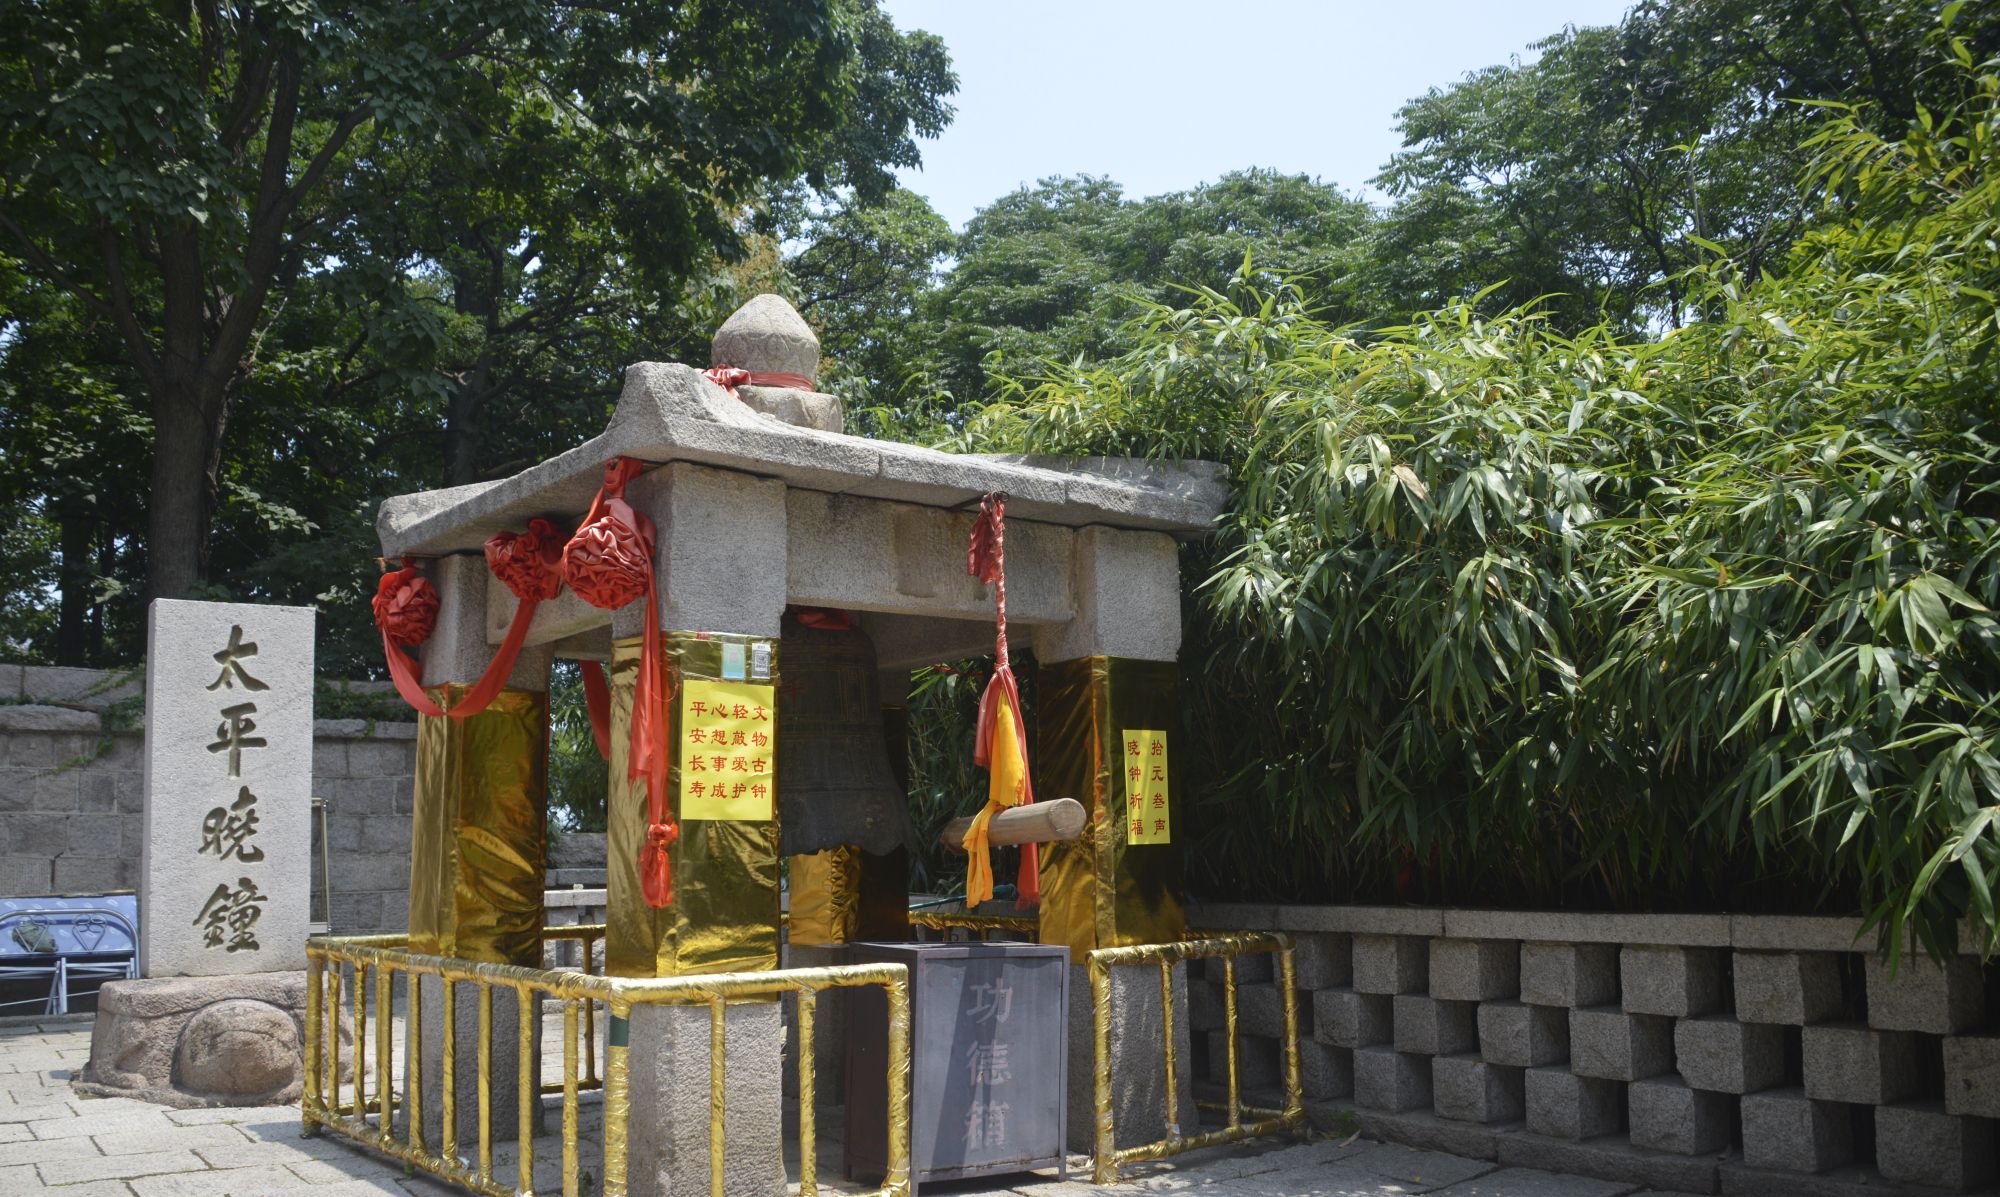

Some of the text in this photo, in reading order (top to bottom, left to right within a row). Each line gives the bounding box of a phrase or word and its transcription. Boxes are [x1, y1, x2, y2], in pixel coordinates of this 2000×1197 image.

[192, 624, 270, 952] 太平曉鐘
[688, 701, 708, 799] 平安长寿
[710, 703, 728, 799] 心想事成
[730, 703, 749, 799] 轻敲爱护
[751, 705, 768, 800] 文物古钟
[1127, 740, 1143, 835] 晓钟祈福
[1151, 739, 1165, 835] 拾元叁声
[961, 977, 1013, 1149] 功德箱
